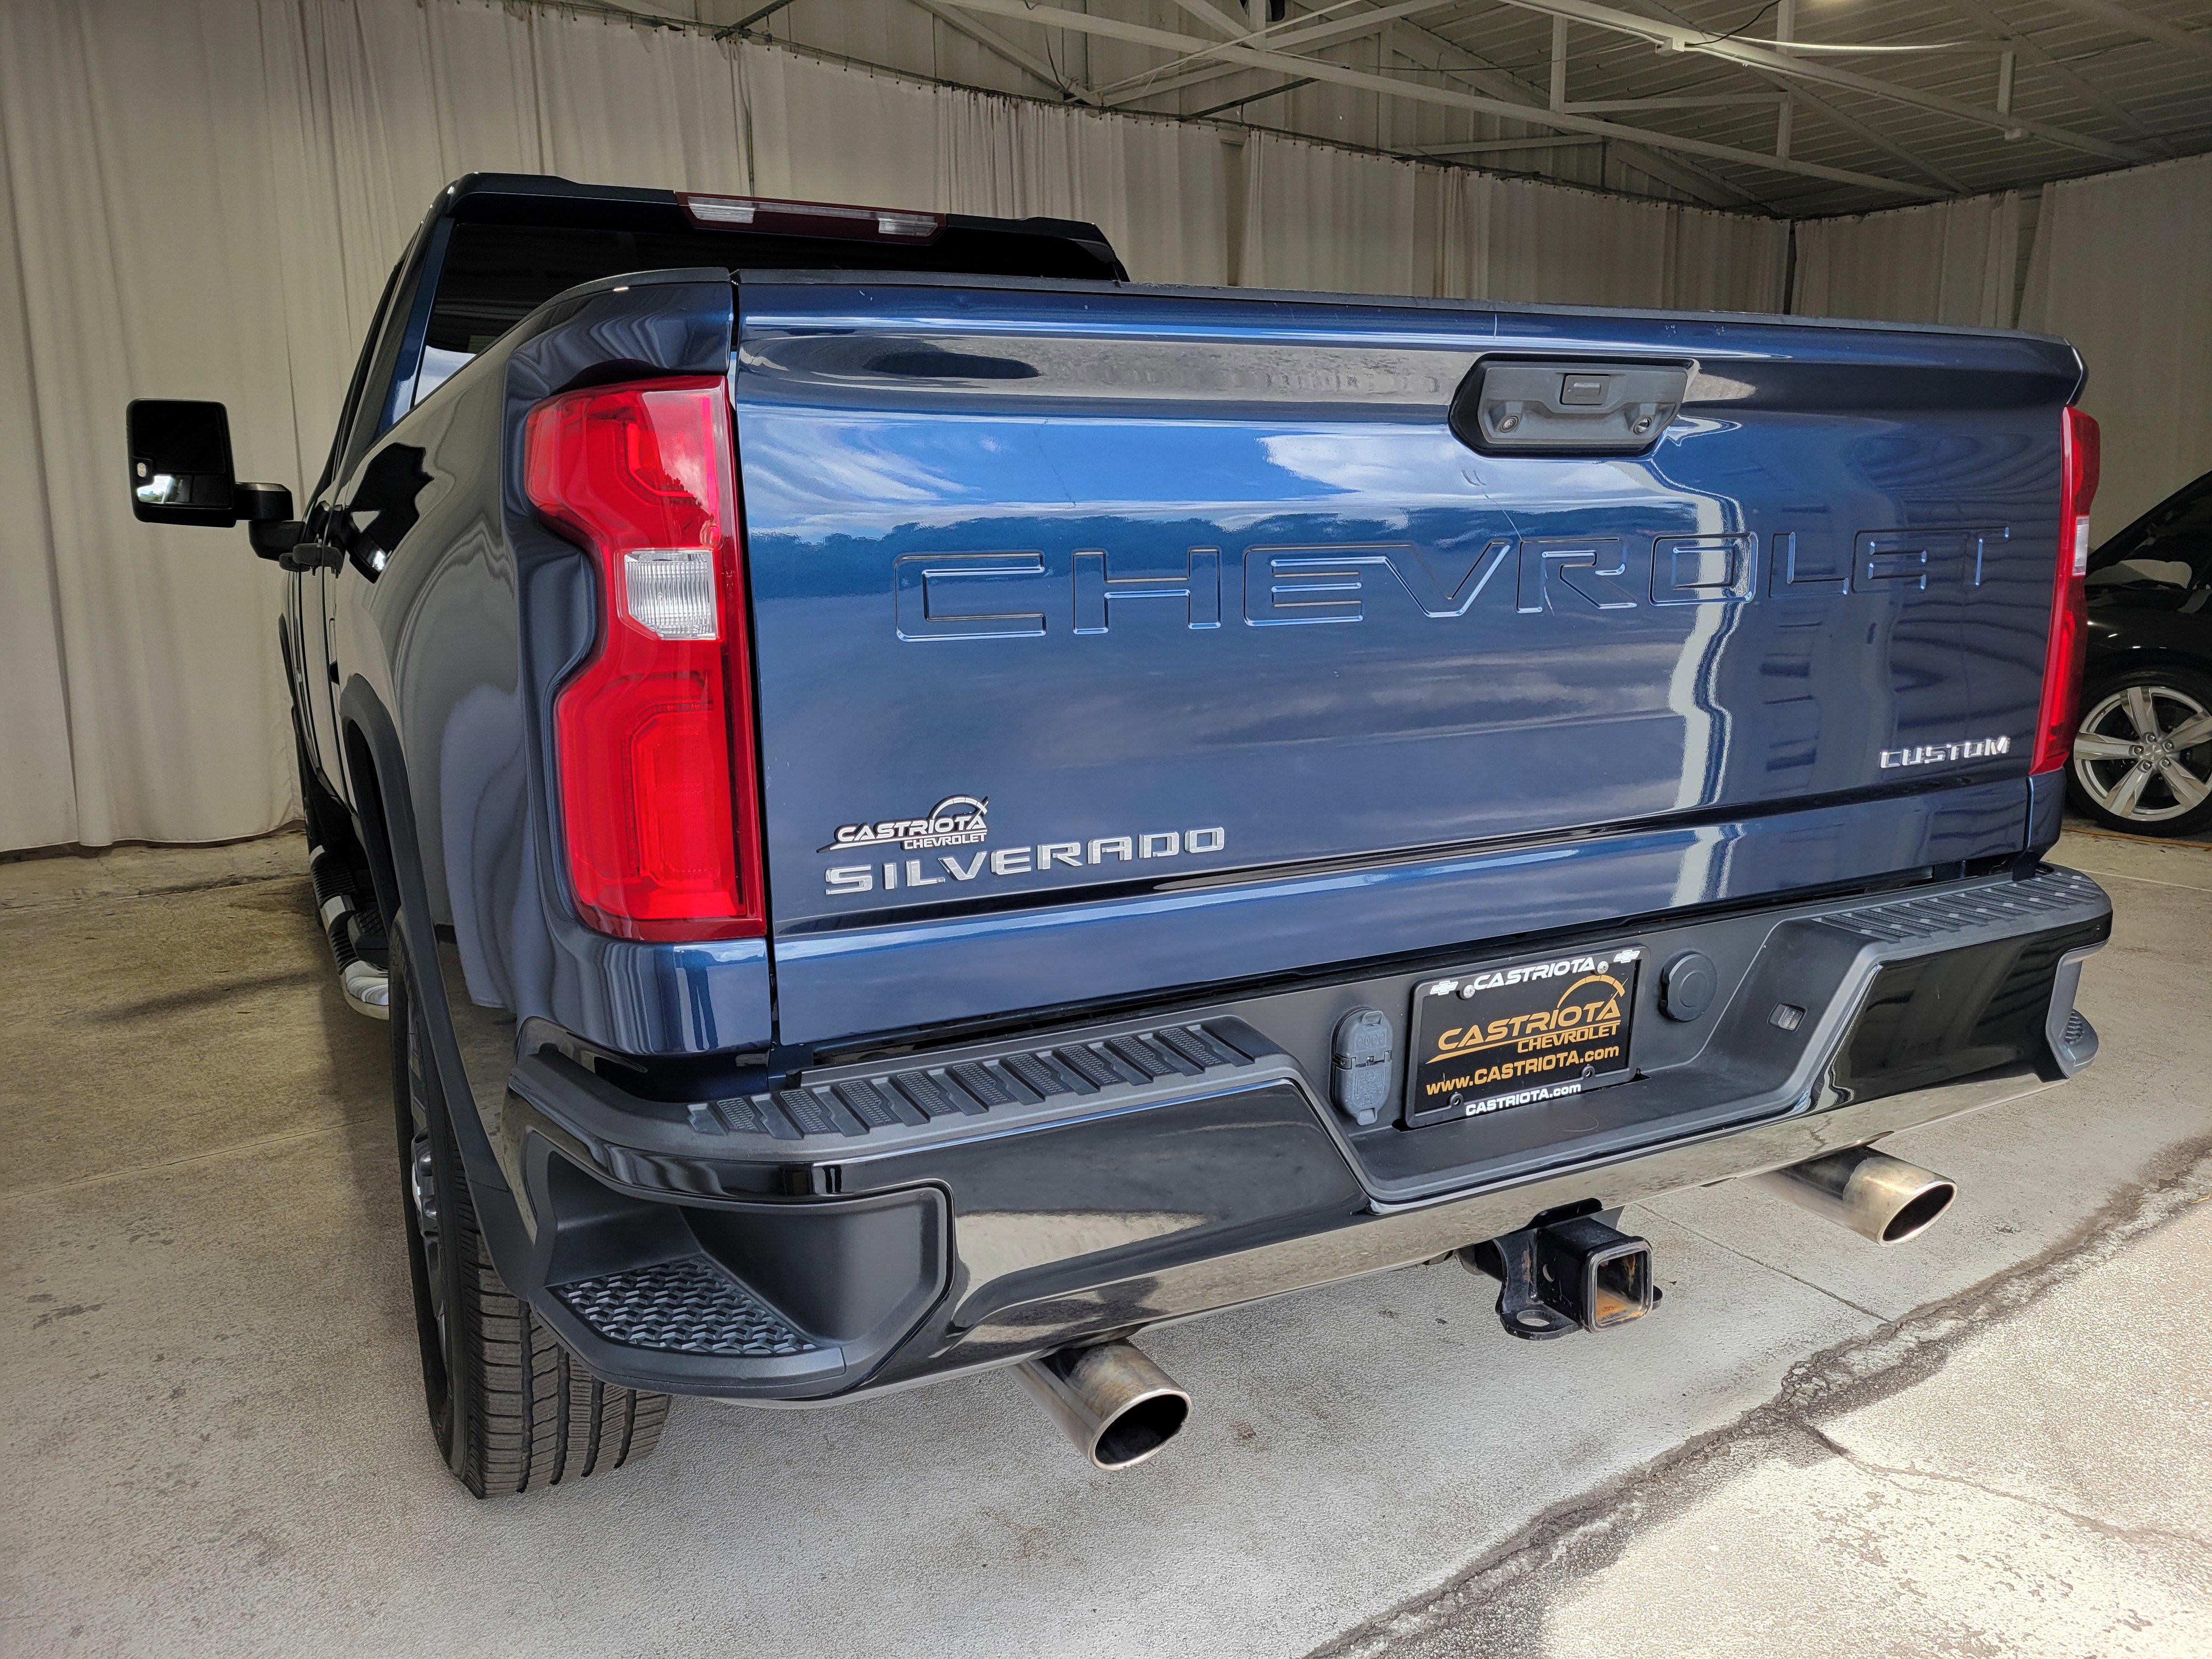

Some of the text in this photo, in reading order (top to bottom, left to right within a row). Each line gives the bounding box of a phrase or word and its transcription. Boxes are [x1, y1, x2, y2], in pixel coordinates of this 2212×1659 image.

[895, 526, 2010, 642] CHEVROLET
[1880, 735, 2010, 769] CUSTOM
[836, 813, 988, 842] CASTRIOTA
[902, 832, 987, 849] CHEVROLET
[825, 826, 1226, 895] SILVERADO
[1473, 957, 1595, 990] CASTRIOTA
[1438, 998, 1621, 1051] CASTRIOTA
[1517, 1022, 1621, 1053] CHEVROLET
[1426, 1044, 1620, 1096] www.CASTRIOTA.com
[1465, 1082, 1582, 1116] CASTRIOTA.com
